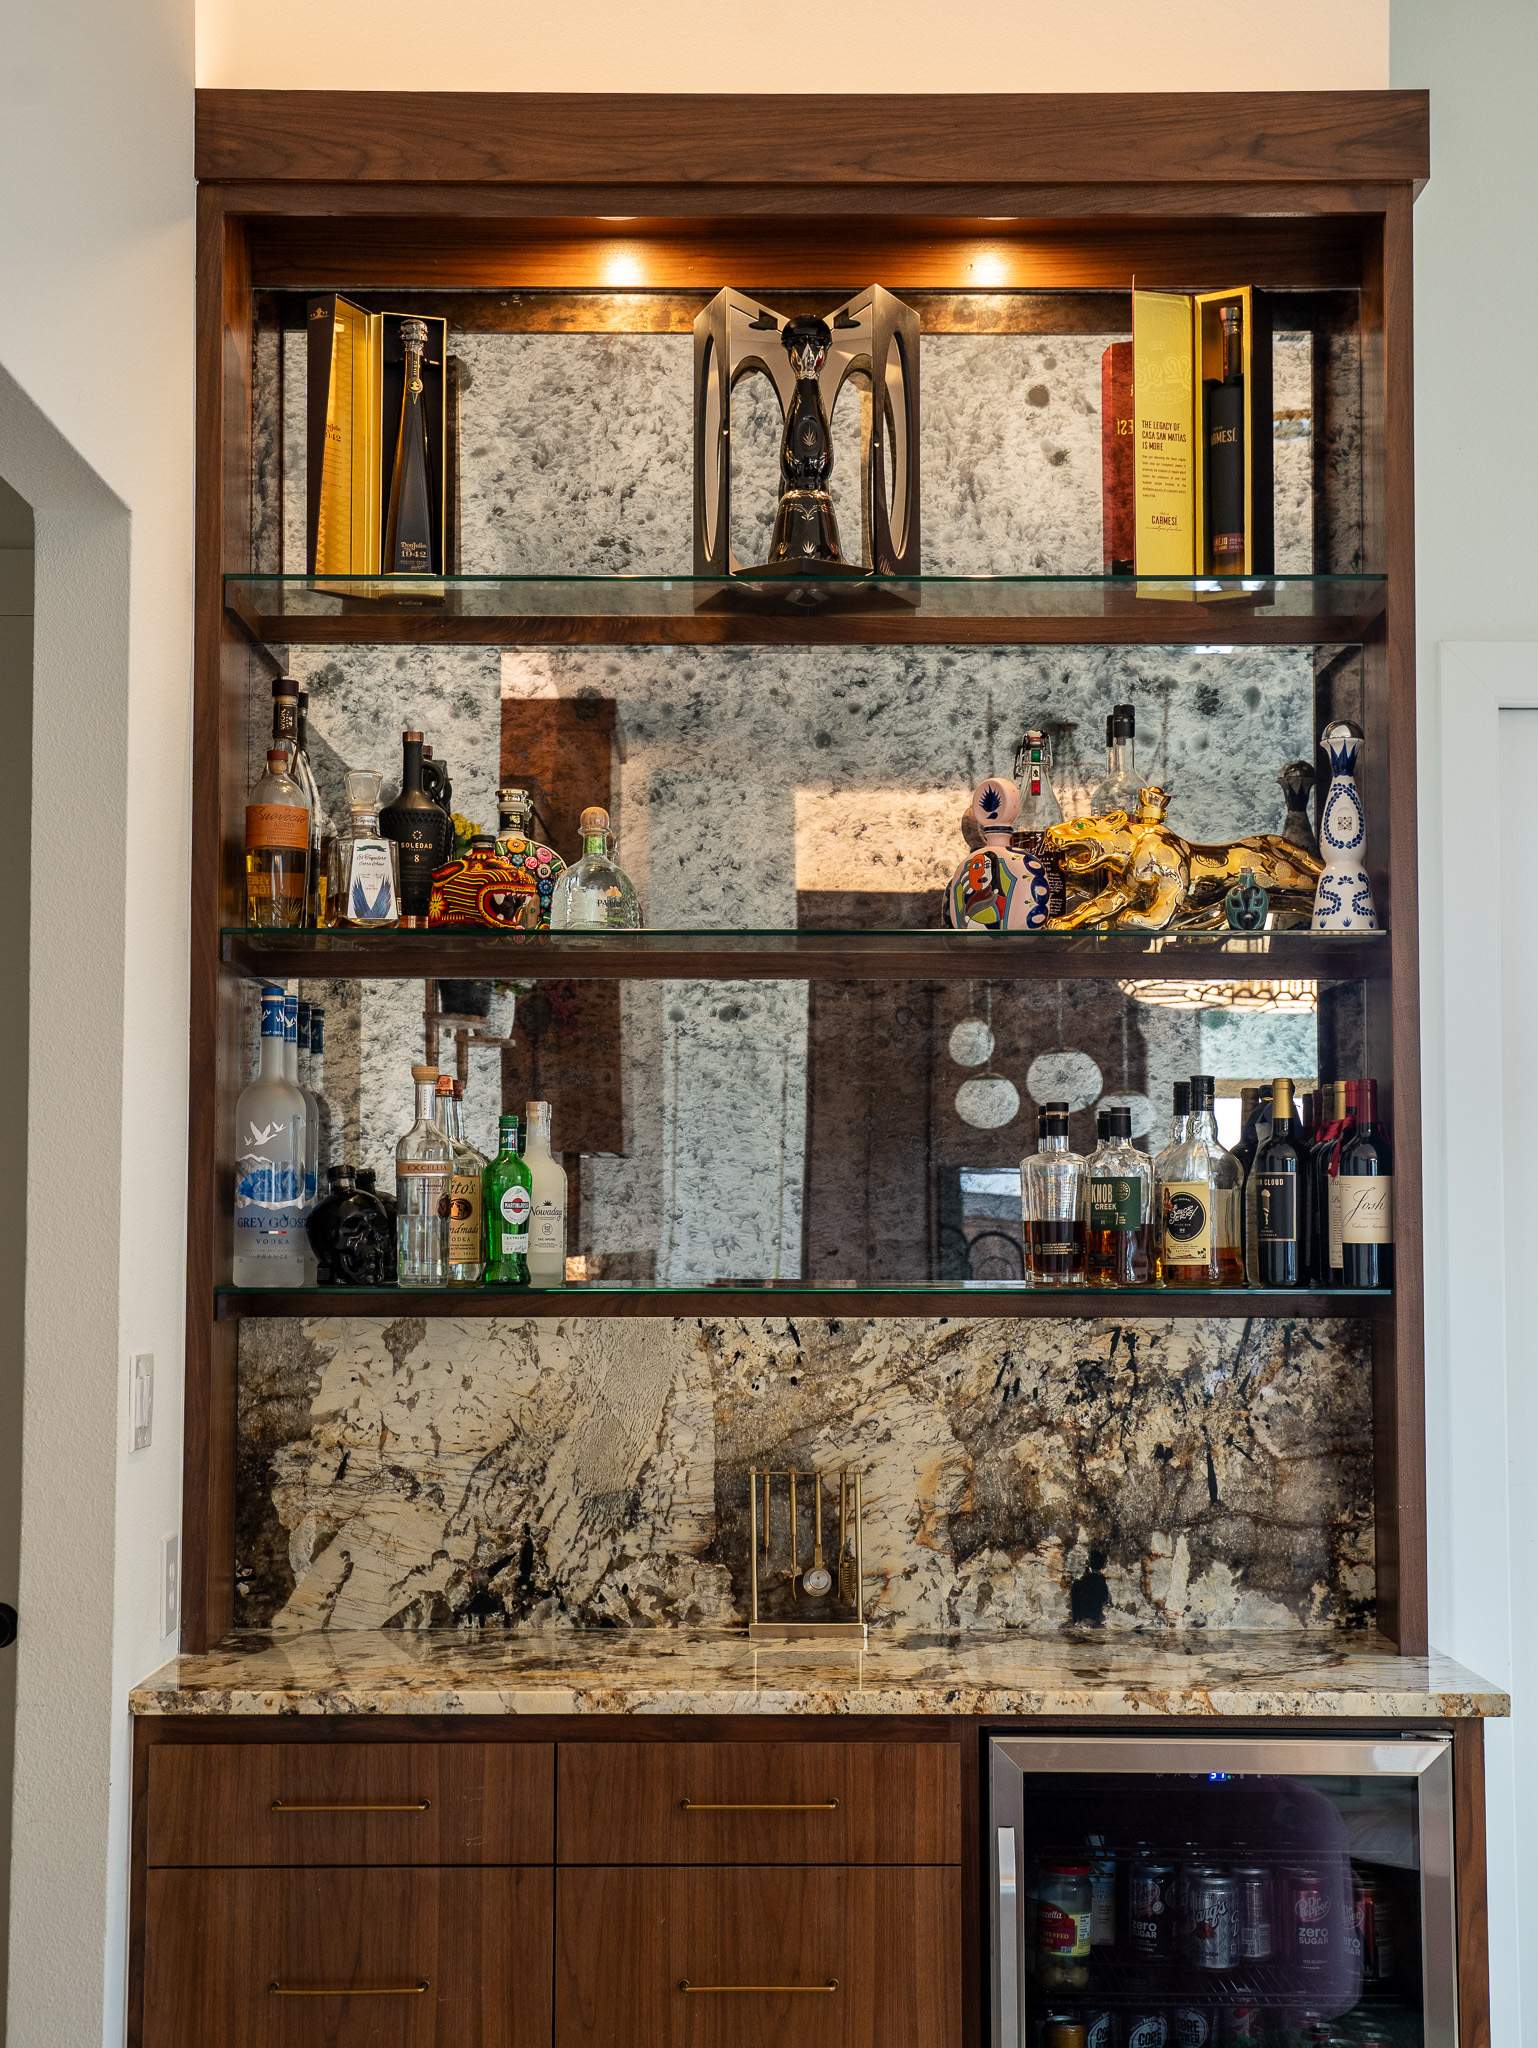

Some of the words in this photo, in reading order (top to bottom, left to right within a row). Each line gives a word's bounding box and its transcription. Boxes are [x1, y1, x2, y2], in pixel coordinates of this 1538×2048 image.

[1142, 420, 1152, 429] THE
[1153, 421, 1172, 431] LEGACY
[1173, 423, 1181, 431] OF
[1142, 431, 1155, 440] CASA
[1156, 433, 1167, 441] SAN
[1168, 434, 1187, 443] MATIAS
[1142, 442, 1148, 450] IS
[1149, 443, 1163, 452] MORE
[401, 551, 428, 559] 1942
[400, 842, 433, 850] SOLEDAD
[414, 854, 420, 863] 8
[1264, 1178, 1285, 1186] CLOUD
[1091, 1183, 1113, 1204] KNOB
[1343, 1186, 1387, 1225] Josh
[237, 1217, 265, 1228] GREY
[1115, 1212, 1119, 1225] 7
[1298, 1927, 1329, 1938] zero
[1298, 1936, 1329, 1945] SUGAR
